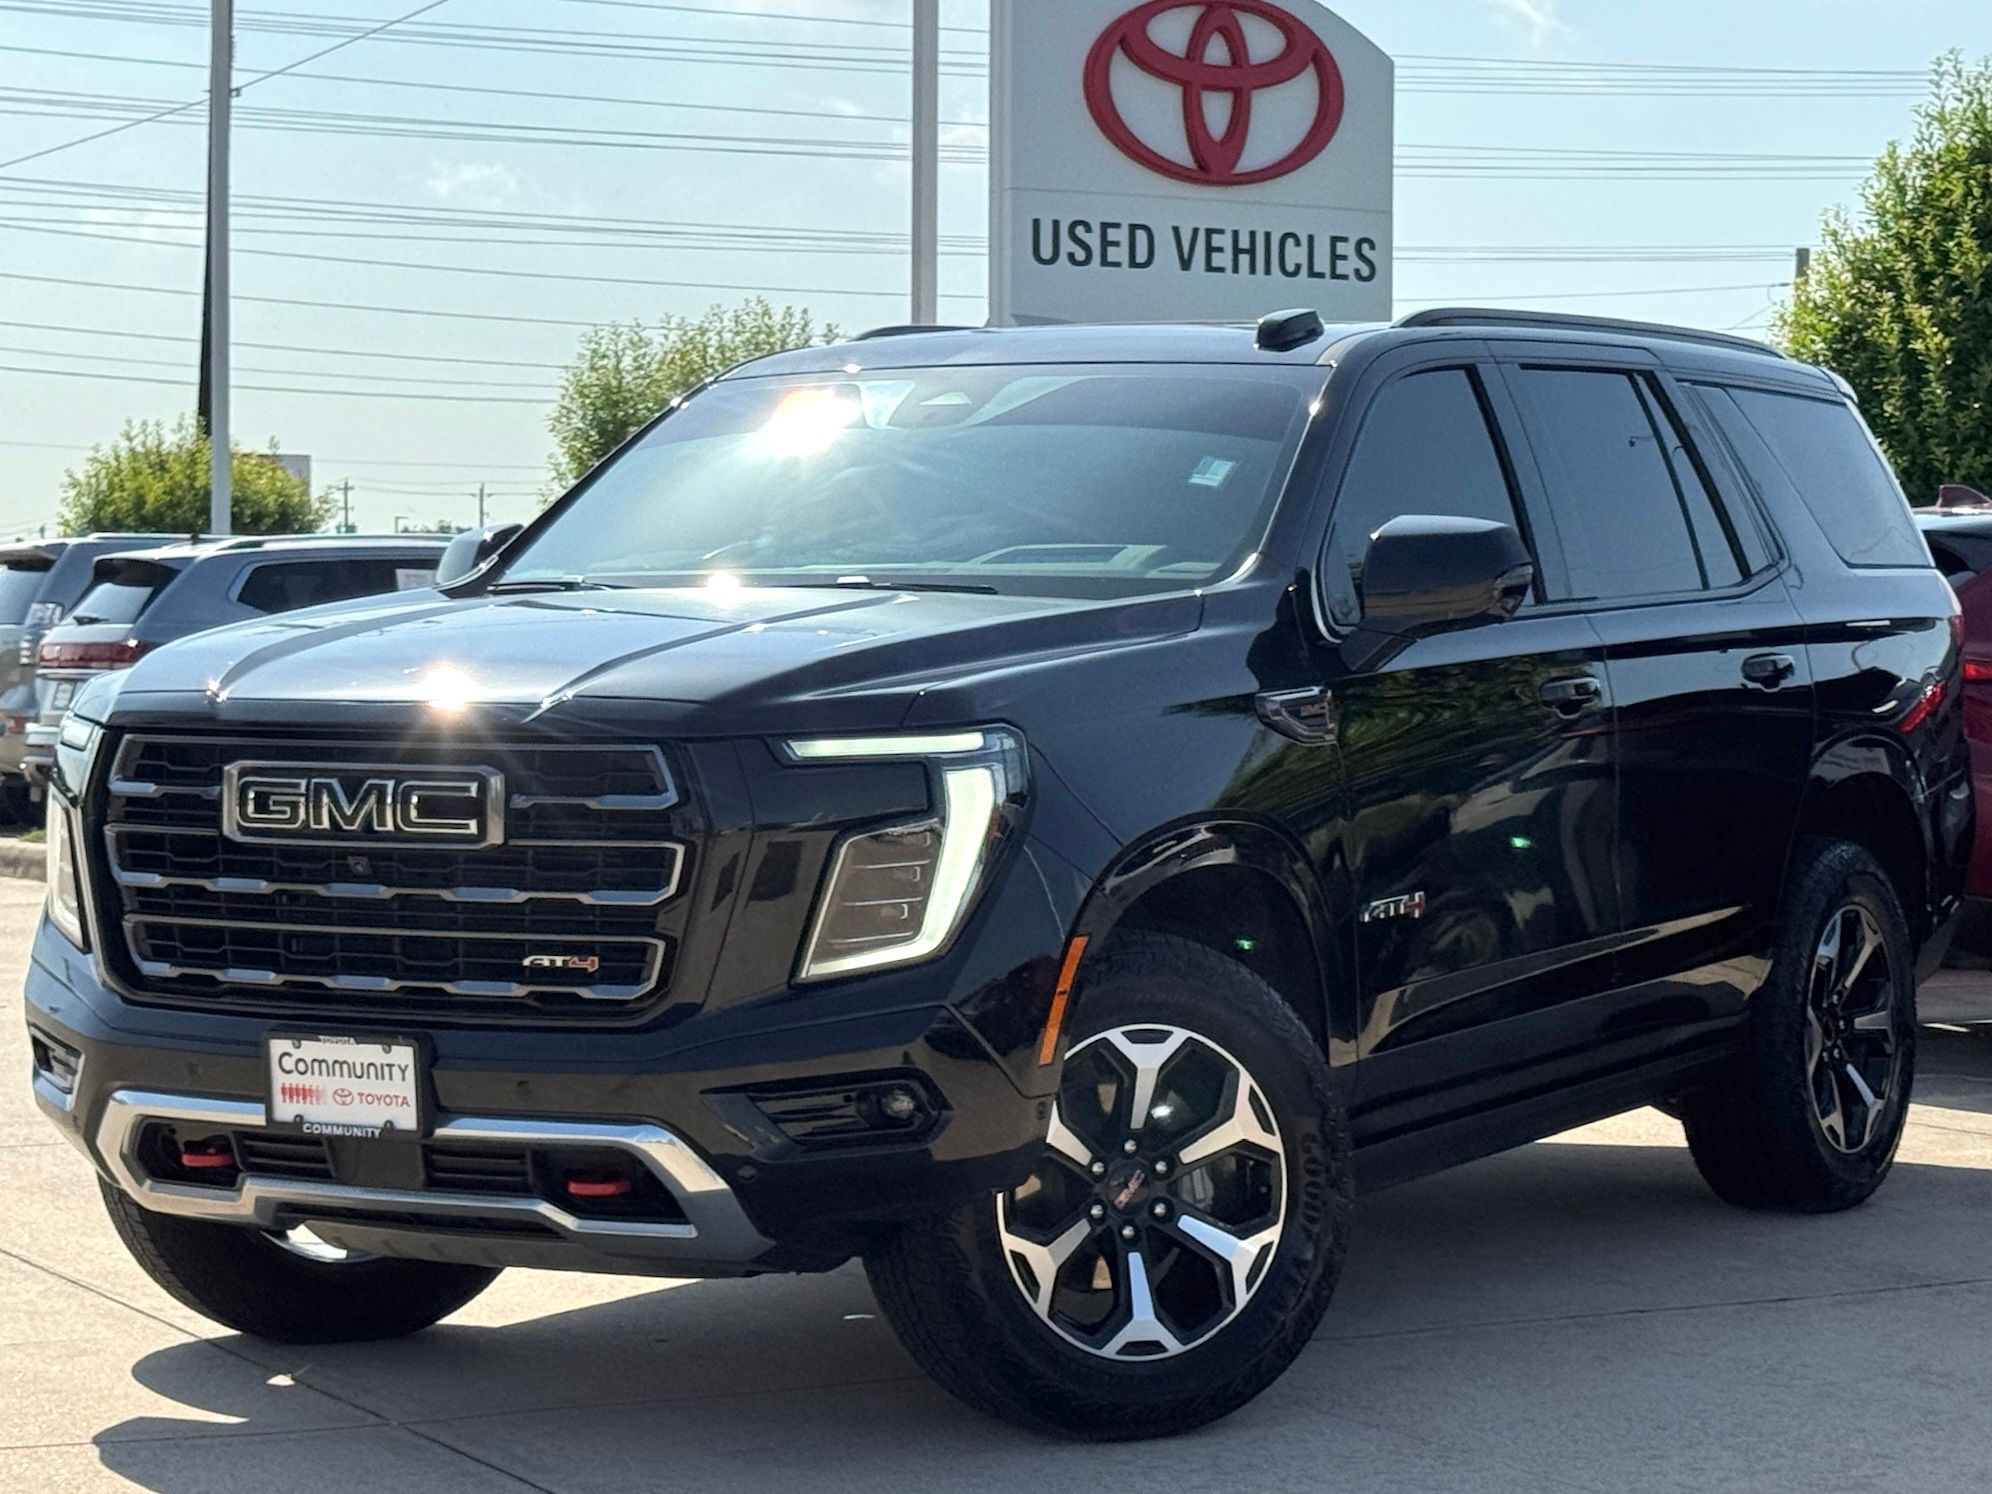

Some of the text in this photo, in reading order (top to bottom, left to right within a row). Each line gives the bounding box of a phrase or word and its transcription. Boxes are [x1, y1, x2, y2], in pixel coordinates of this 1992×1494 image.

[1031, 218, 1377, 283] USED VEHICLES
[237, 777, 479, 835] GMC
[522, 954, 600, 973] AT4
[357, 1091, 411, 1107] TOYOTA
[302, 1123, 383, 1139] COMMUNITY
